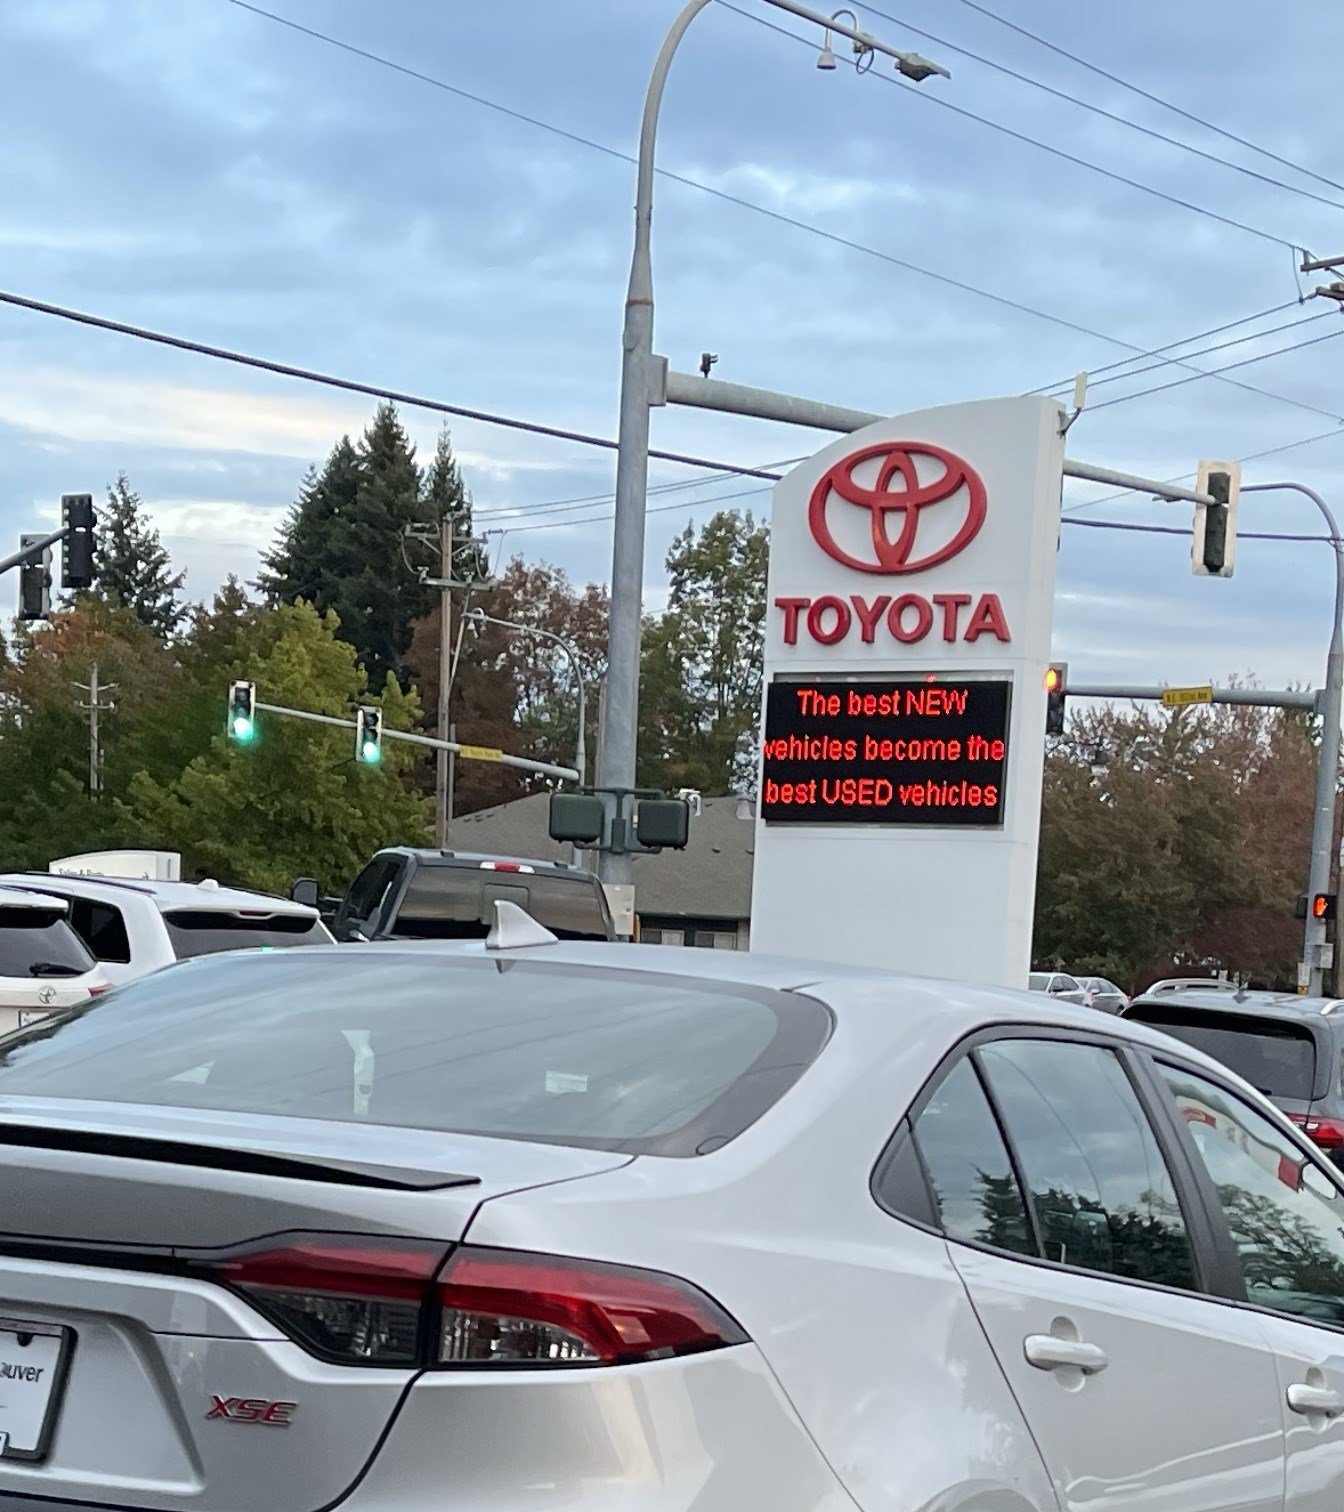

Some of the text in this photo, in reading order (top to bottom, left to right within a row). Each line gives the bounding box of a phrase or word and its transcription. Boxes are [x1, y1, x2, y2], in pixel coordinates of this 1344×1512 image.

[774, 593, 1012, 645] TOYOTA
[796, 689, 969, 716] The best NEW
[763, 734, 1006, 761] vehicles become the
[765, 778, 998, 807] best USED vehicles
[205, 1394, 300, 1426] XSE
